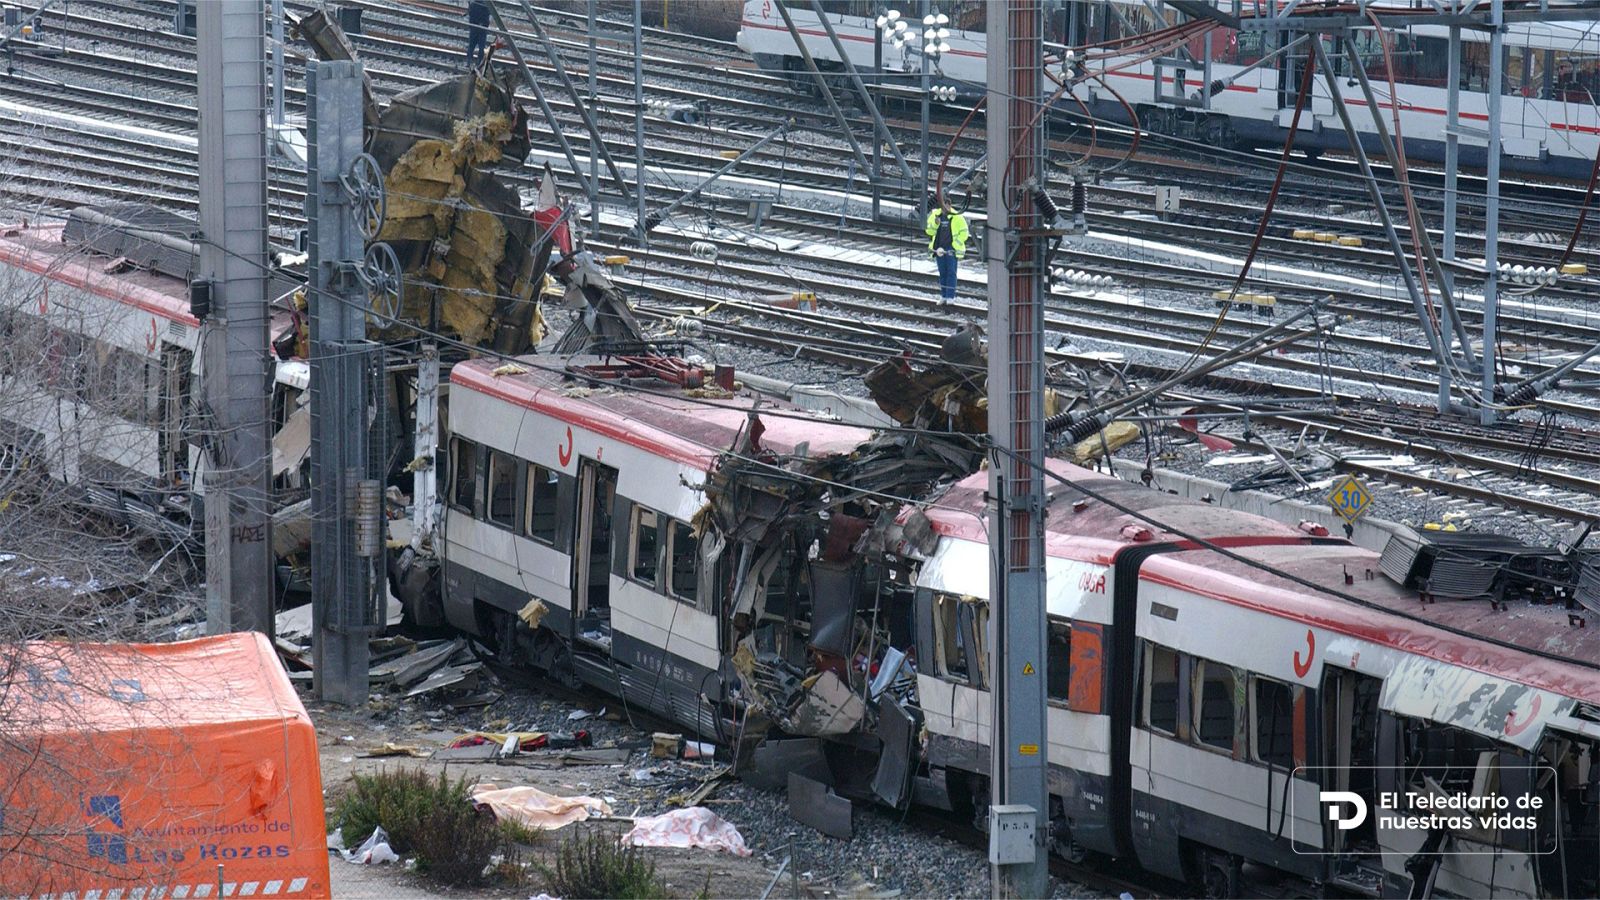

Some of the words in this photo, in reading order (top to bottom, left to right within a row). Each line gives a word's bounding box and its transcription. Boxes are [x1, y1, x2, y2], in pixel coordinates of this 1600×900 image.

[1164, 199, 1171, 210] 2
[1340, 490, 1360, 509] 30
[268, 820, 290, 833] de
[134, 847, 185, 864] Las
[200, 844, 290, 861] Rozas
